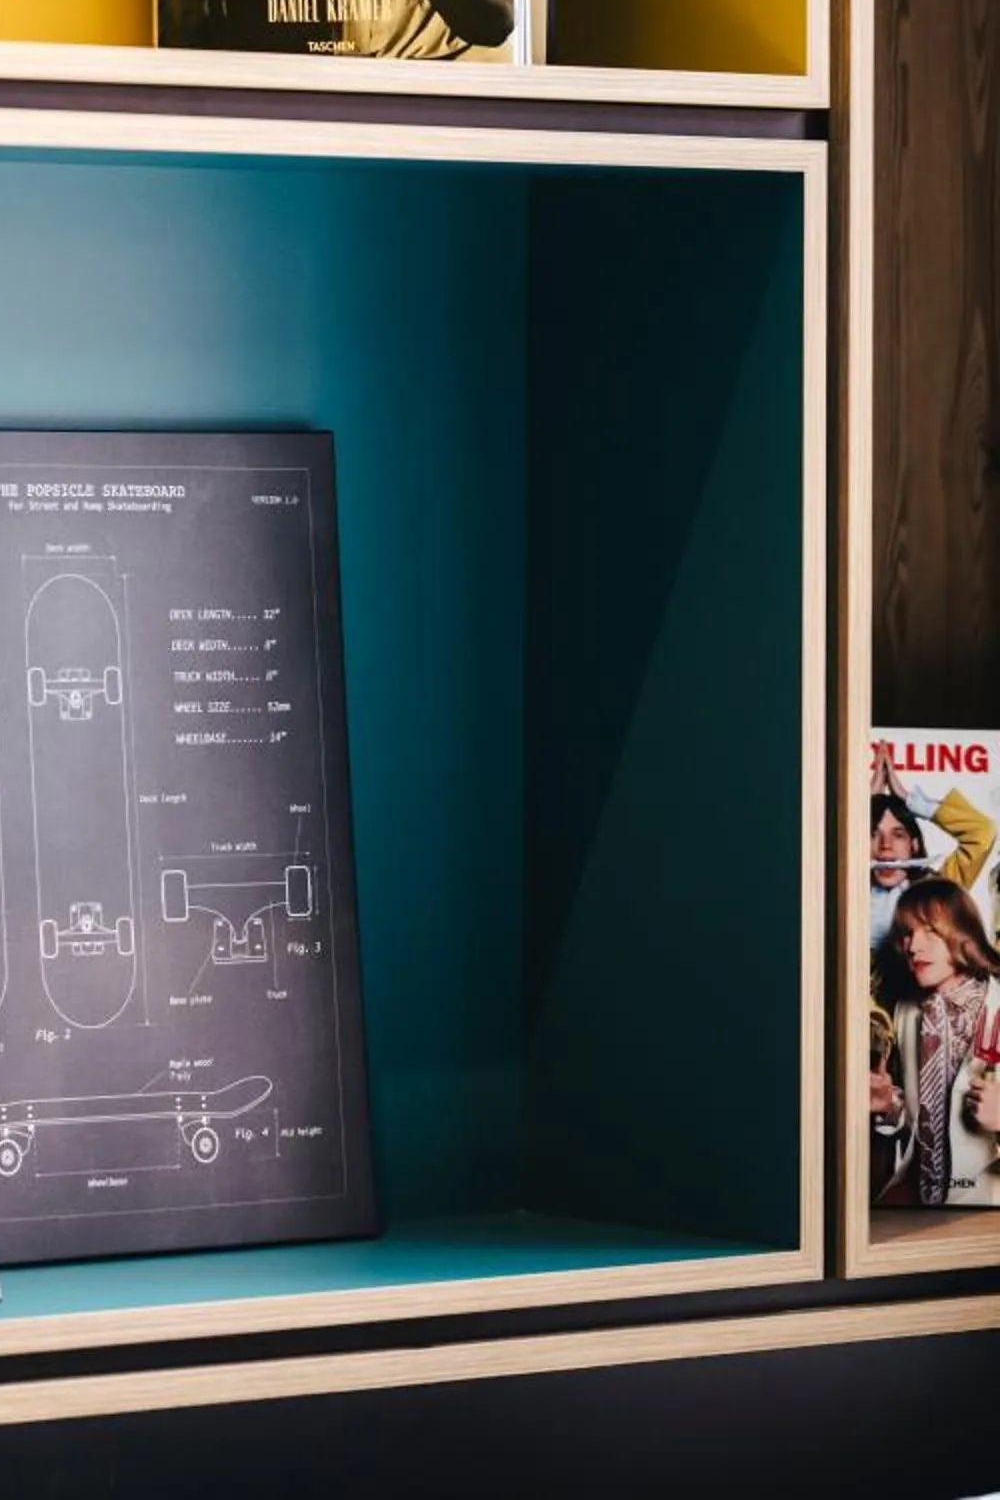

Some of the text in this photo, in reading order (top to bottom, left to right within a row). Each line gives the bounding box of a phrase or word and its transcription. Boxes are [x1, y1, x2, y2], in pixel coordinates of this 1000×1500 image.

[307, 40, 356, 53] TASCHEN
[26, 483, 96, 498] POPSICLE
[102, 484, 188, 498] SKATEBOARD
[171, 639, 195, 651] DECK
[286, 940, 322, 957] Fig. 3
[35, 1028, 58, 1044] Fig.
